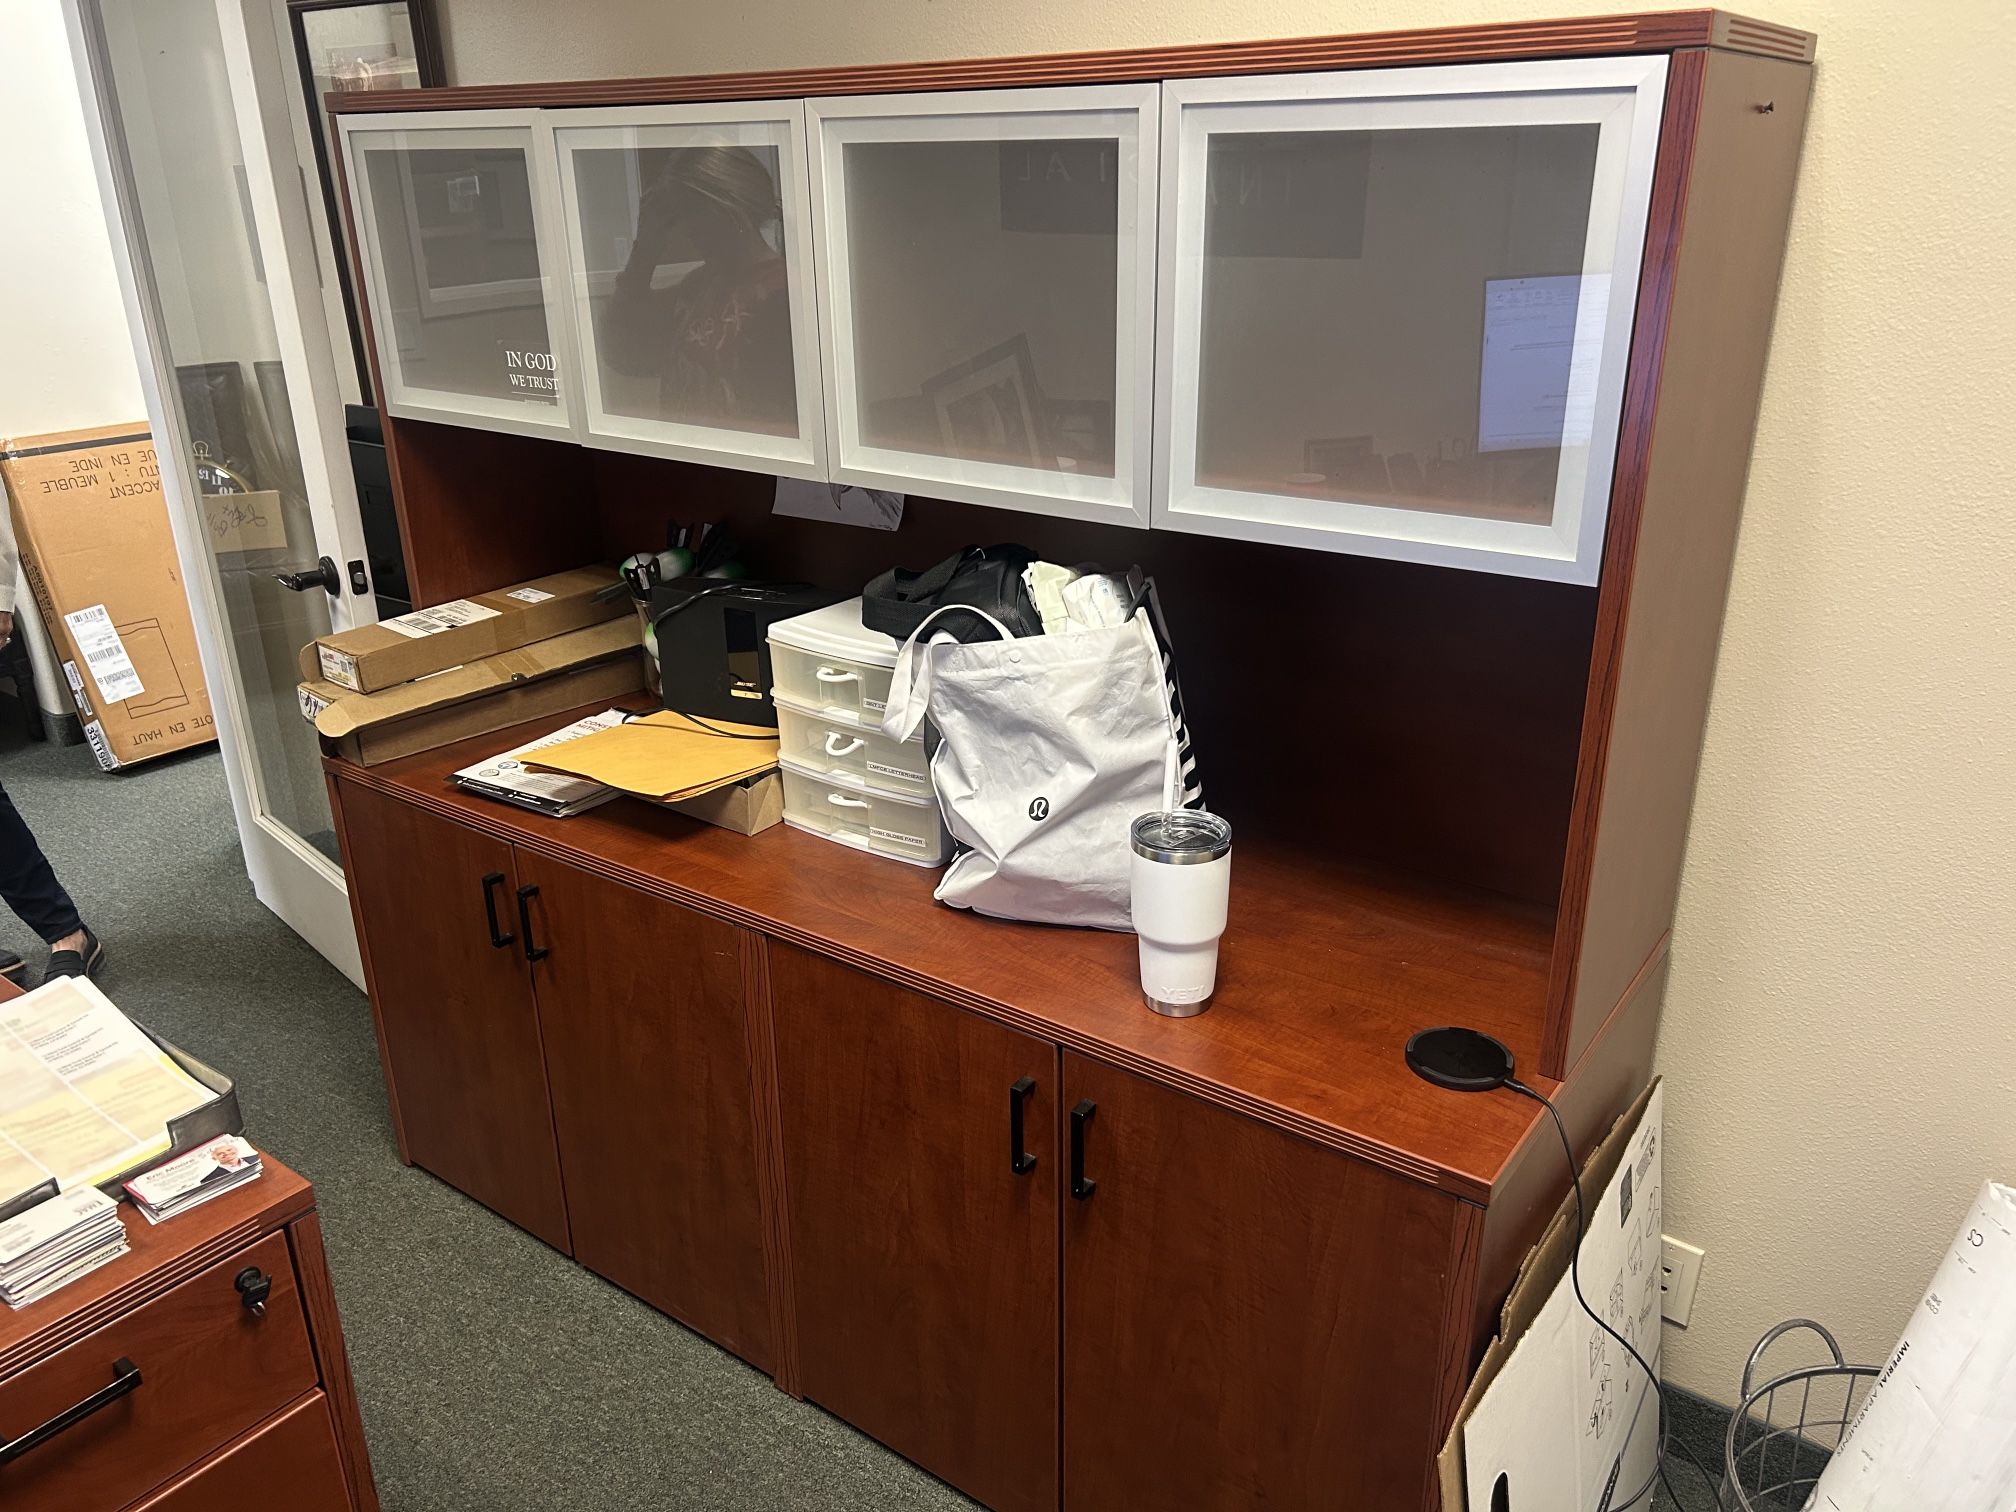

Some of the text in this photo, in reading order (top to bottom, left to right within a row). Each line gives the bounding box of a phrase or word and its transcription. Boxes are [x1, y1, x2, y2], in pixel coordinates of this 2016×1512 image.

[505, 350, 557, 371] IN GOD
[509, 374, 560, 391] WE TRUST
[68, 457, 103, 473] INDE
[110, 453, 131, 466] EN
[40, 473, 99, 494] MEUBLE
[109, 480, 160, 499] ACCENT
[168, 722, 186, 735] EN
[132, 729, 163, 746] HAUT
[1161, 985, 1205, 1000] YETI
[1836, 1340, 1910, 1457] IMPERIAL APARTMENTS
